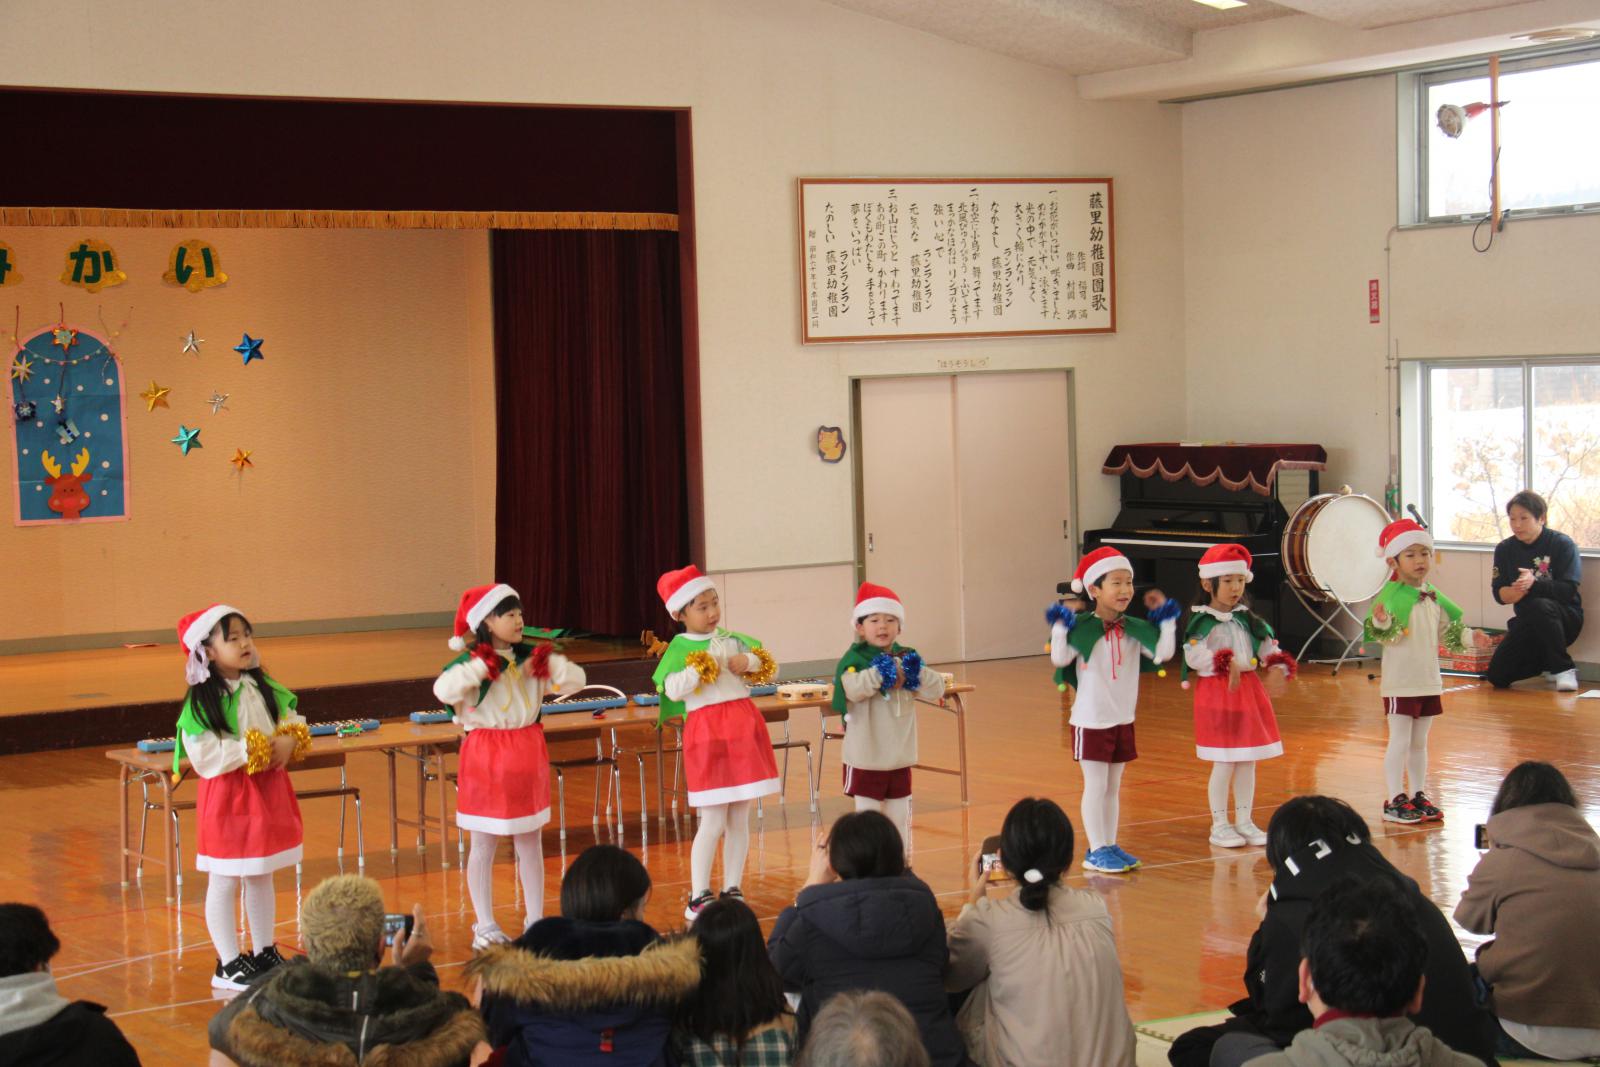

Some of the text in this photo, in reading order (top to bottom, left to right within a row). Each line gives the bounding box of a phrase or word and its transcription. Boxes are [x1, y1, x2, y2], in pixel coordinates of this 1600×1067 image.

[824, 201, 835, 244] たのしい
[909, 203, 920, 243] 元気な
[990, 201, 1000, 248] なかよし
[1025, 201, 1036, 249] 光の中で
[839, 250, 850, 314] ランランラン
[922, 249, 932, 311] ランランラン
[1003, 247, 1013, 308] ランランラン
[1065, 252, 1075, 271] 作曲
